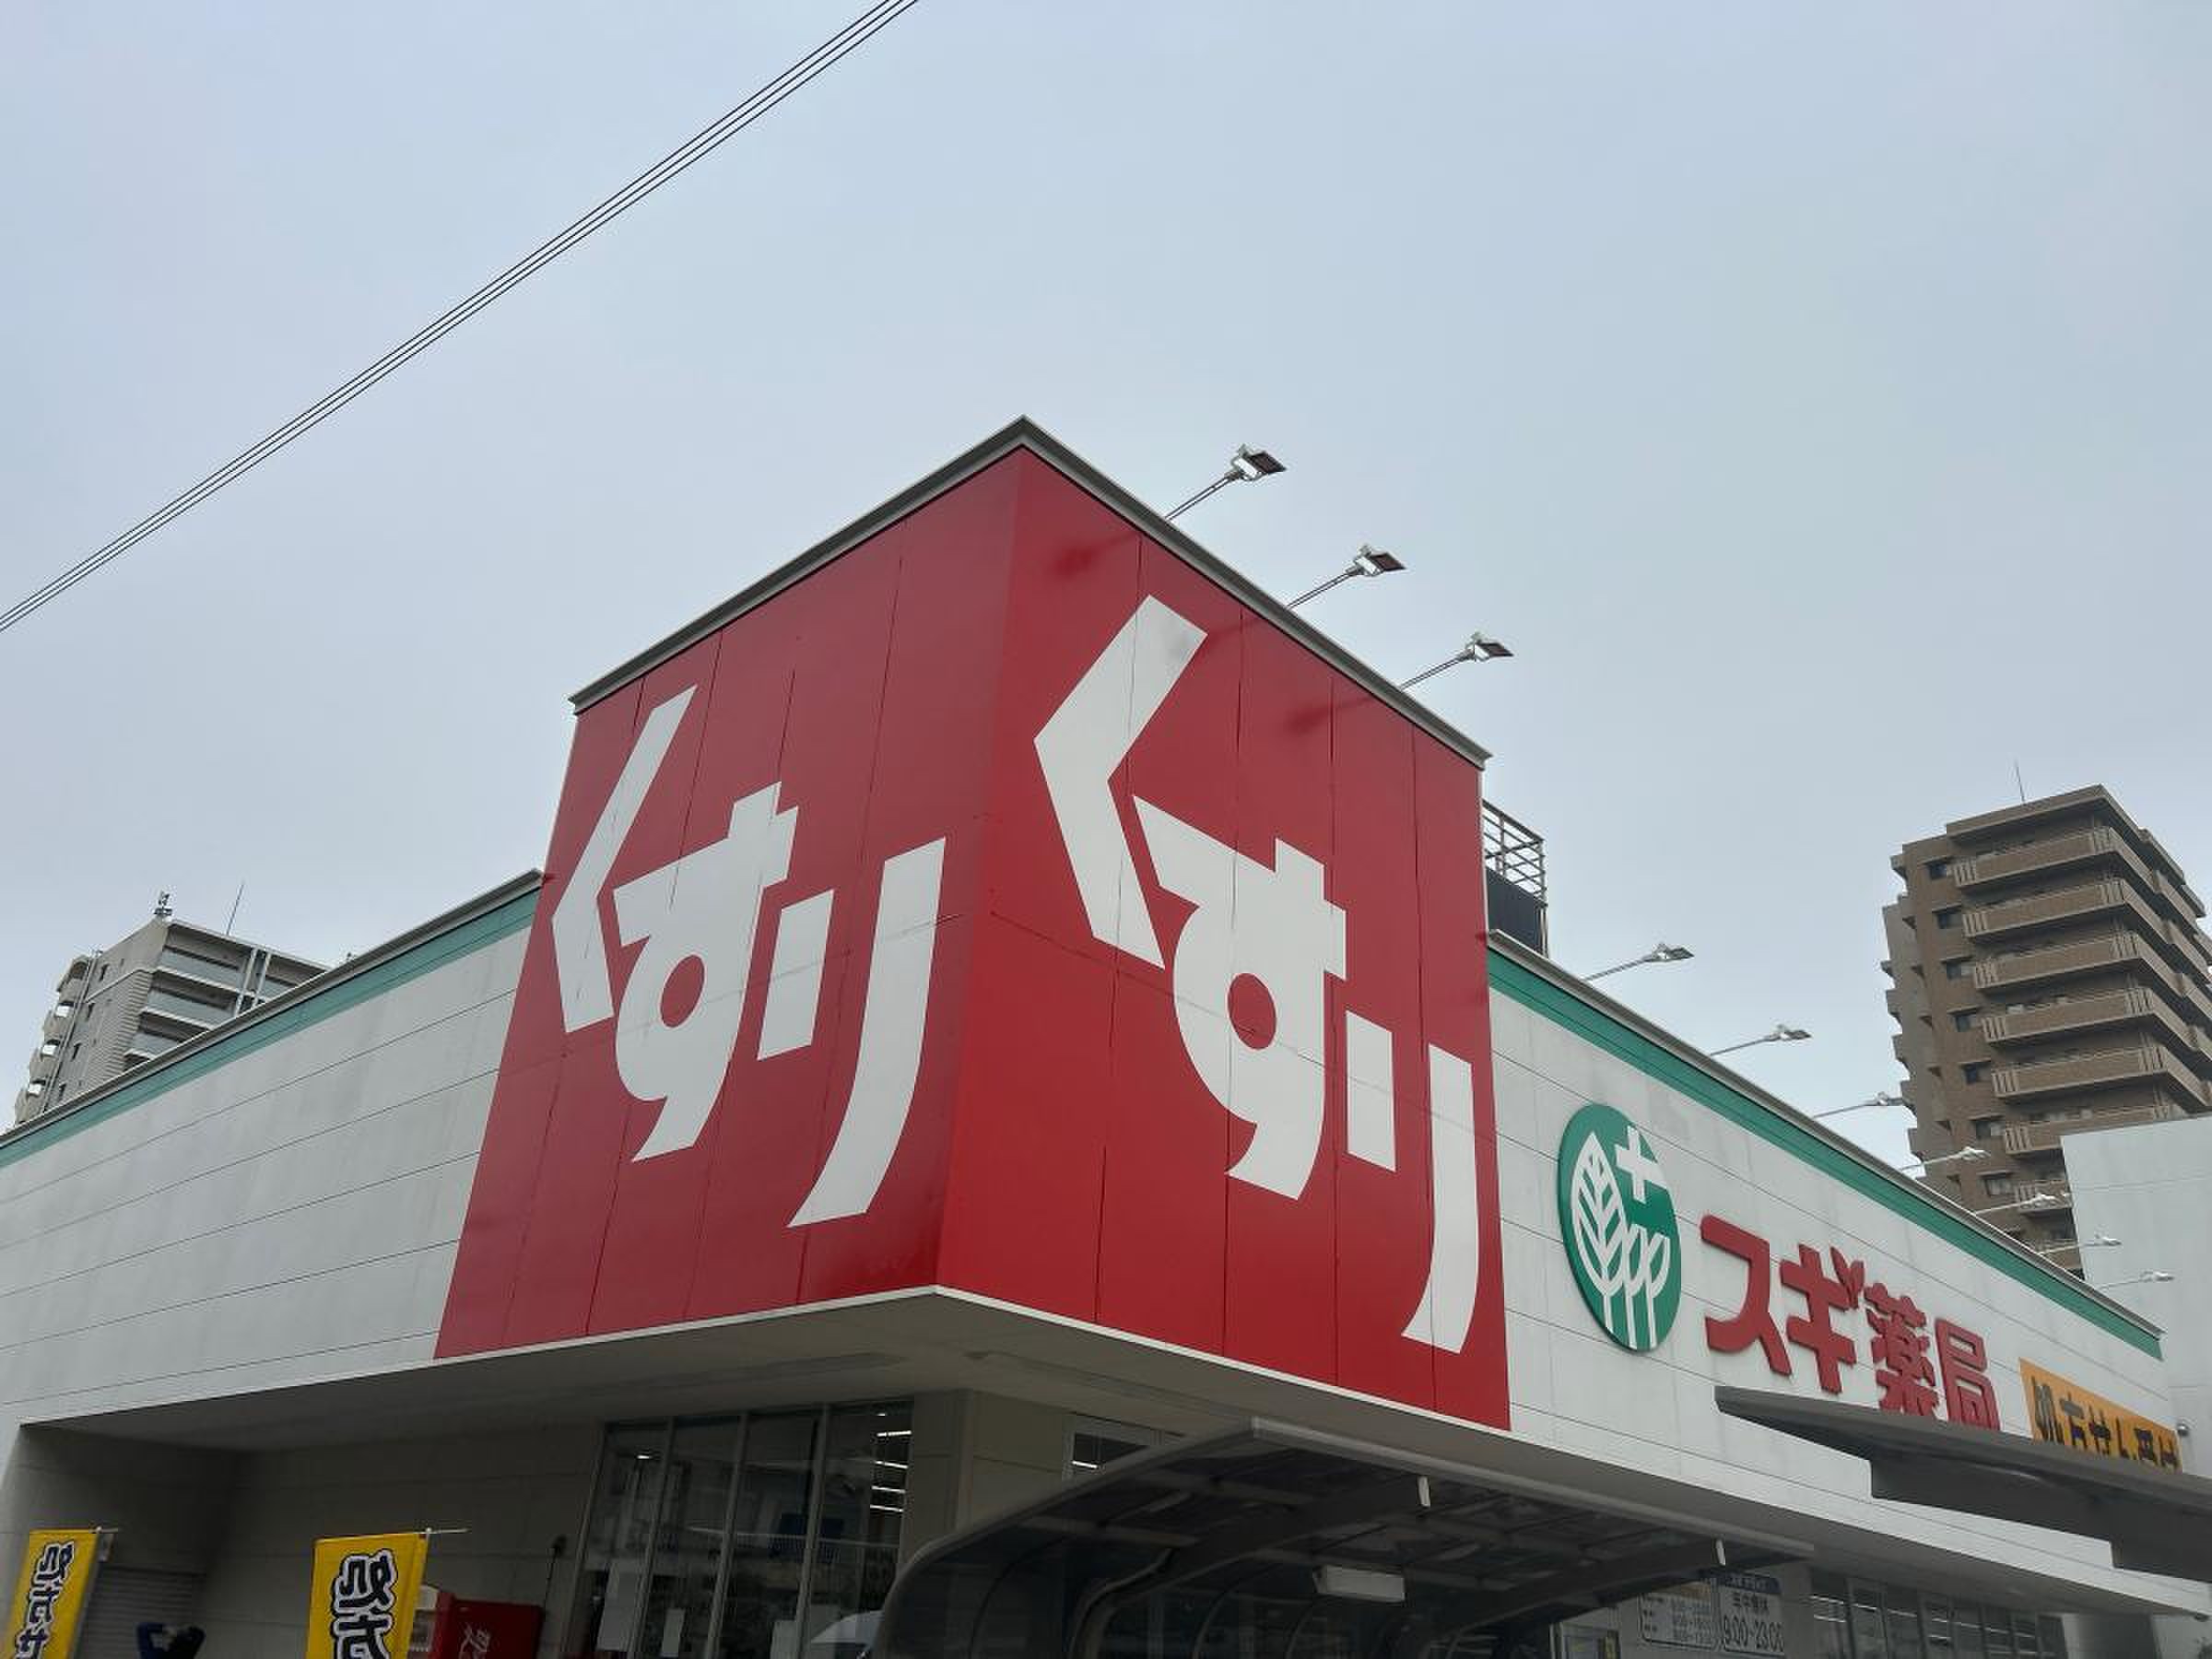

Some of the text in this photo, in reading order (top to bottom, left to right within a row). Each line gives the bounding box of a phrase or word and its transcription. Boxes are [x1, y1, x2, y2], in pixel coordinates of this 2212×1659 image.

[551, 685, 946, 1227] くすり
[1034, 594, 1478, 1355] くすり
[1700, 1214, 2001, 1430] スギ薬局
